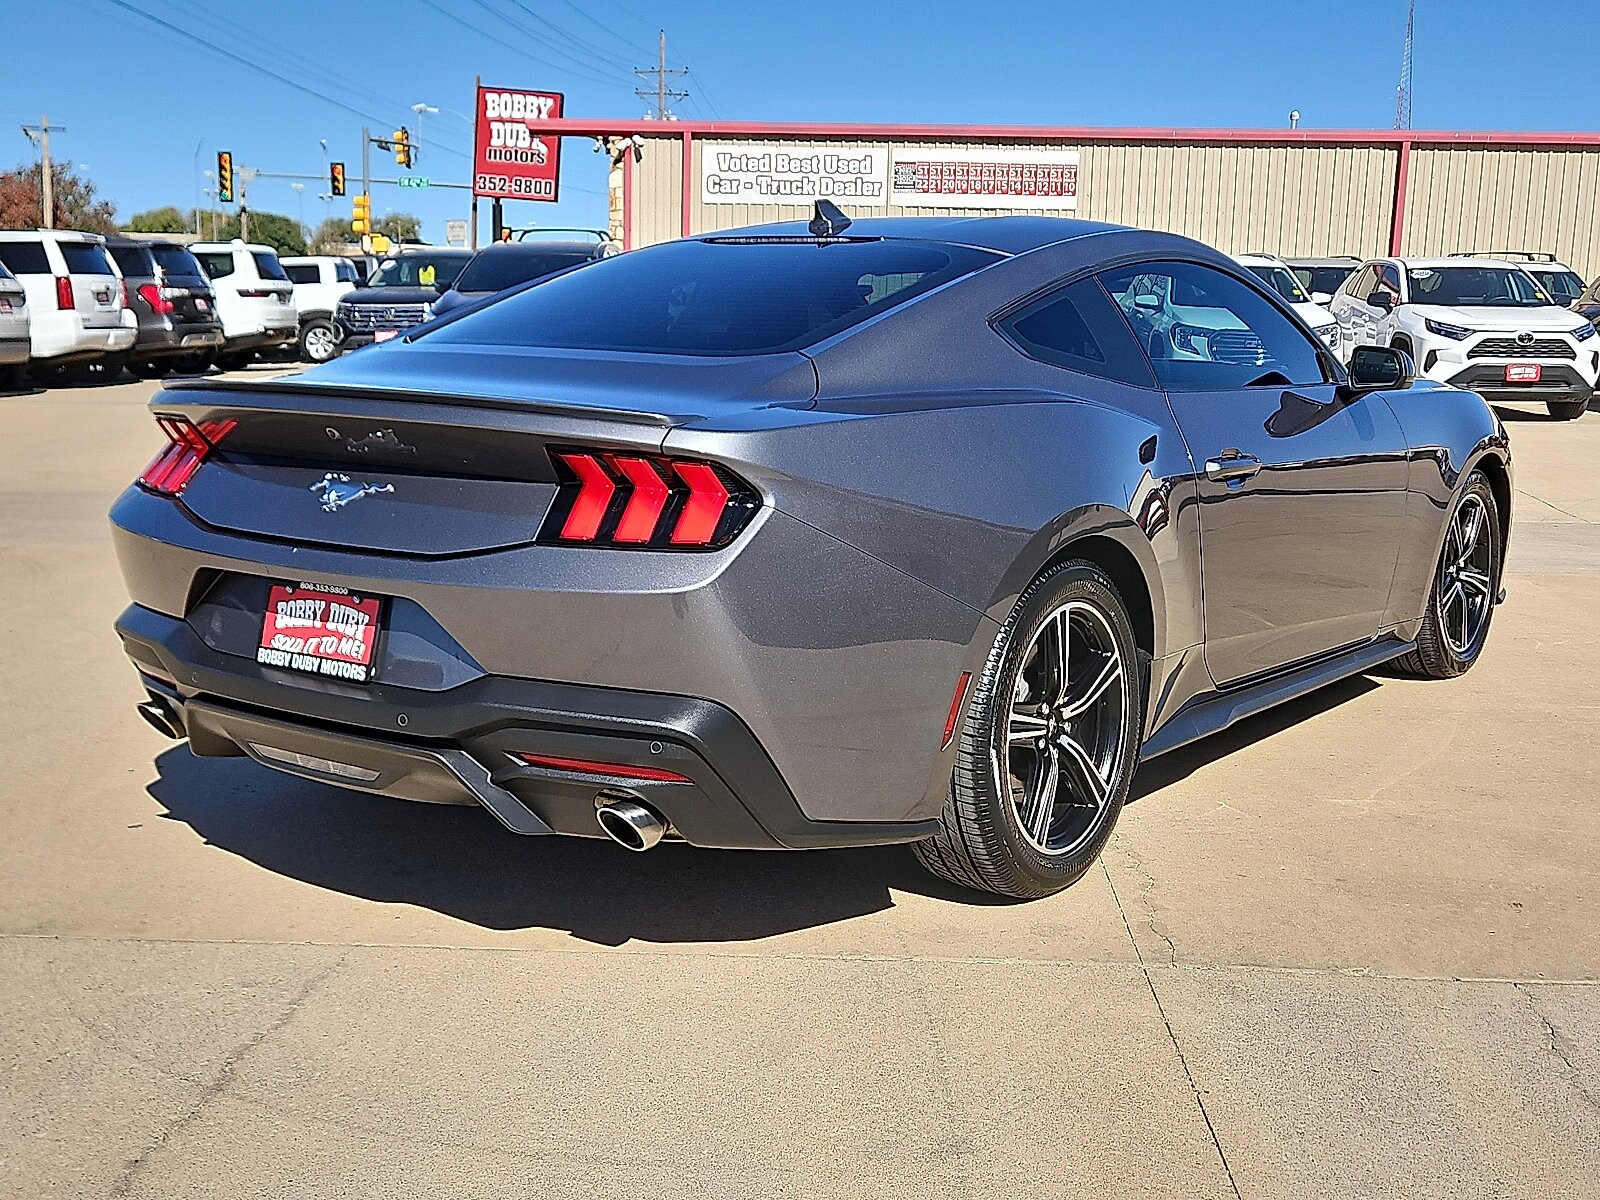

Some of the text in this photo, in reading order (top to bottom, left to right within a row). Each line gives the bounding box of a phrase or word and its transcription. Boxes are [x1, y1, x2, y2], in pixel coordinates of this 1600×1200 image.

[485, 92, 554, 119] BOBBY
[490, 121, 541, 149] DUB
[487, 148, 546, 165] motors
[717, 152, 873, 174] Voted Best Used
[478, 175, 553, 195] 352-9800
[706, 174, 740, 195] Car
[756, 175, 816, 195] Truck
[819, 177, 882, 197] Dealer
[917, 180, 1075, 192] 22 21 20 19 18 17 15 14 13 12 11 10
[275, 600, 370, 642] BOBBY DUBY
[270, 633, 305, 653] SOLD
[304, 637, 321, 655] IT
[319, 635, 339, 655] TO
[257, 647, 367, 681] BOBBY DUBY MOTORS
